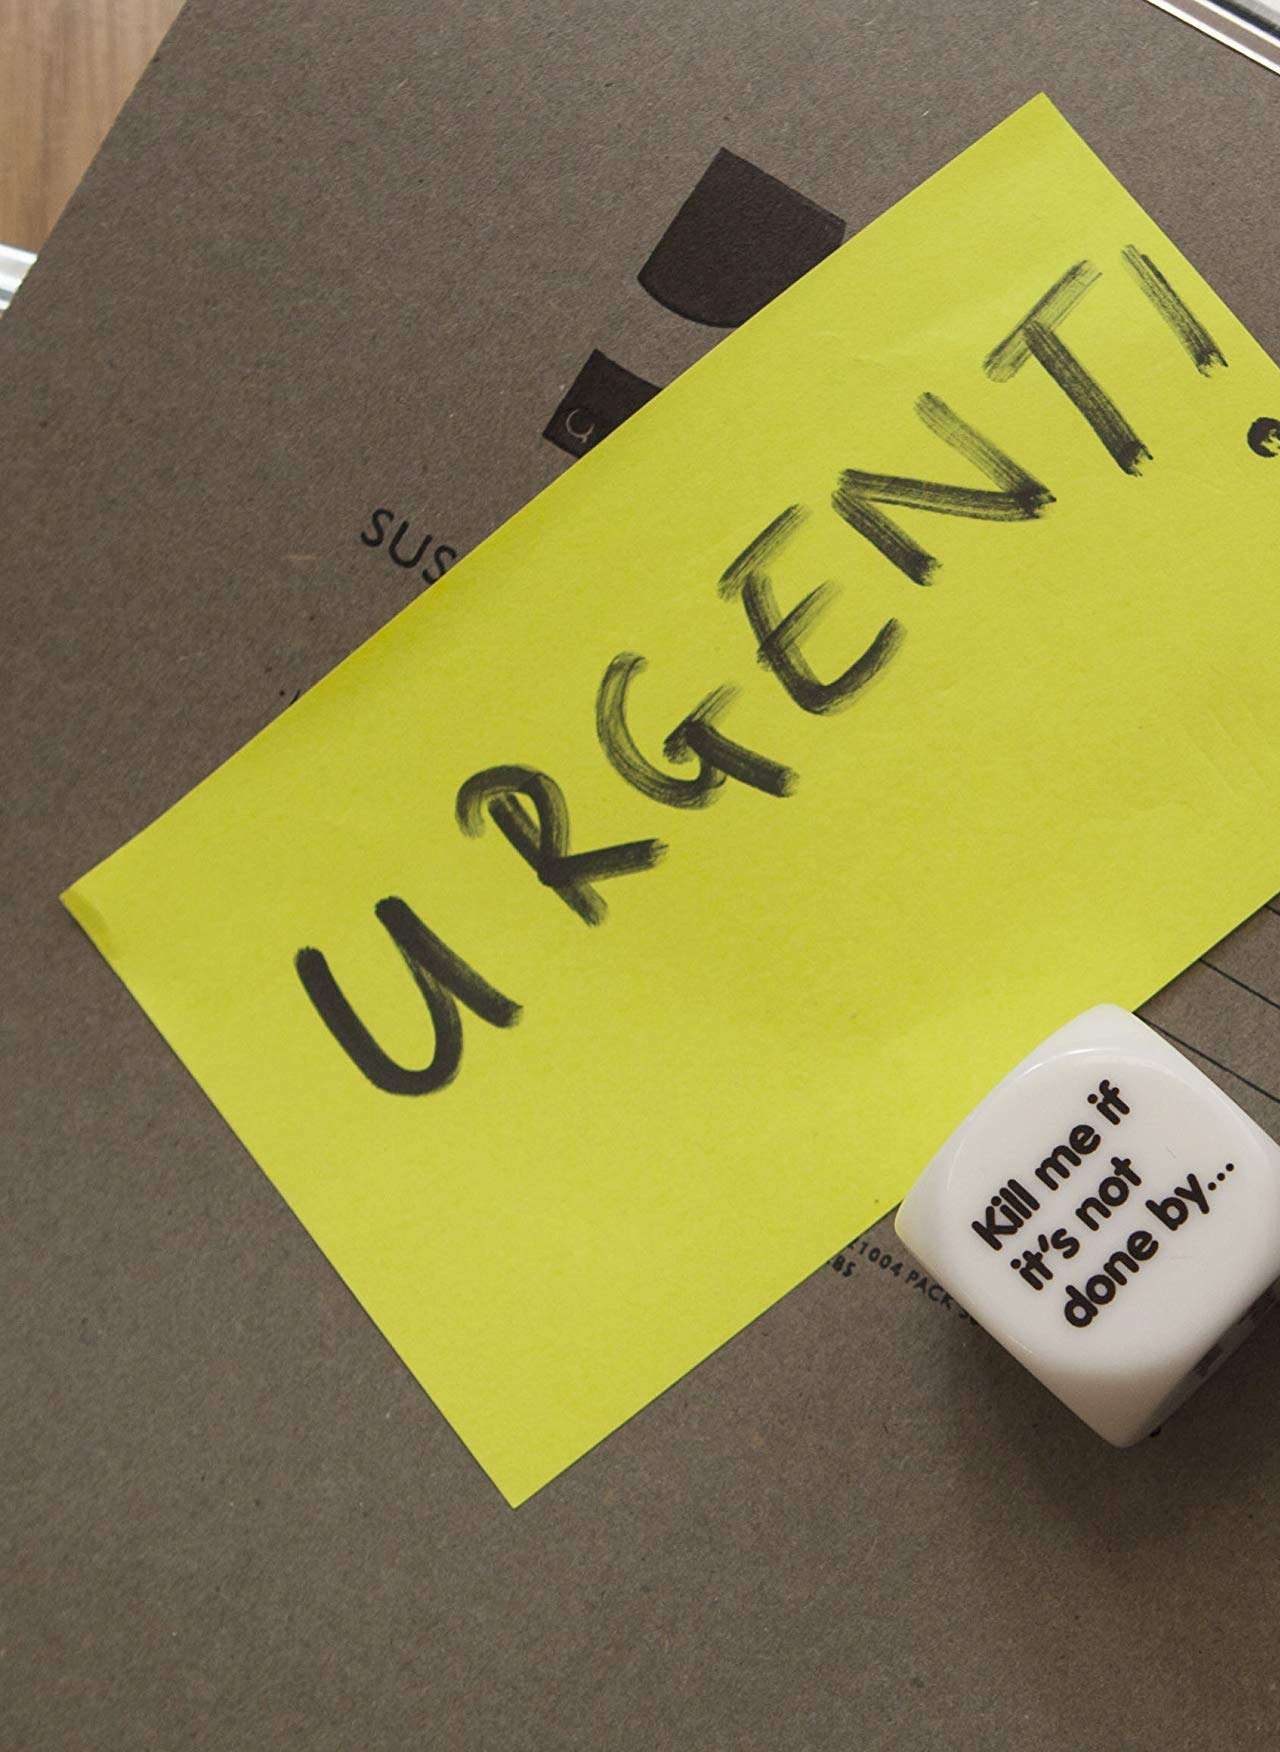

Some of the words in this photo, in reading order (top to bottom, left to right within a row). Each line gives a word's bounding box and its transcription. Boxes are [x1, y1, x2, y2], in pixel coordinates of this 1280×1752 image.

[971, 1178, 1041, 1252] Kill
[1034, 1124, 1102, 1192] me
[1086, 1079, 1130, 1126] if
[1009, 1227, 1081, 1291] it's
[1075, 1156, 1142, 1232] not
[847, 1241, 904, 1277] 1004
[905, 1269, 954, 1309] PACK
[1063, 1230, 1159, 1329] done
[1144, 1163, 1235, 1232] by...
